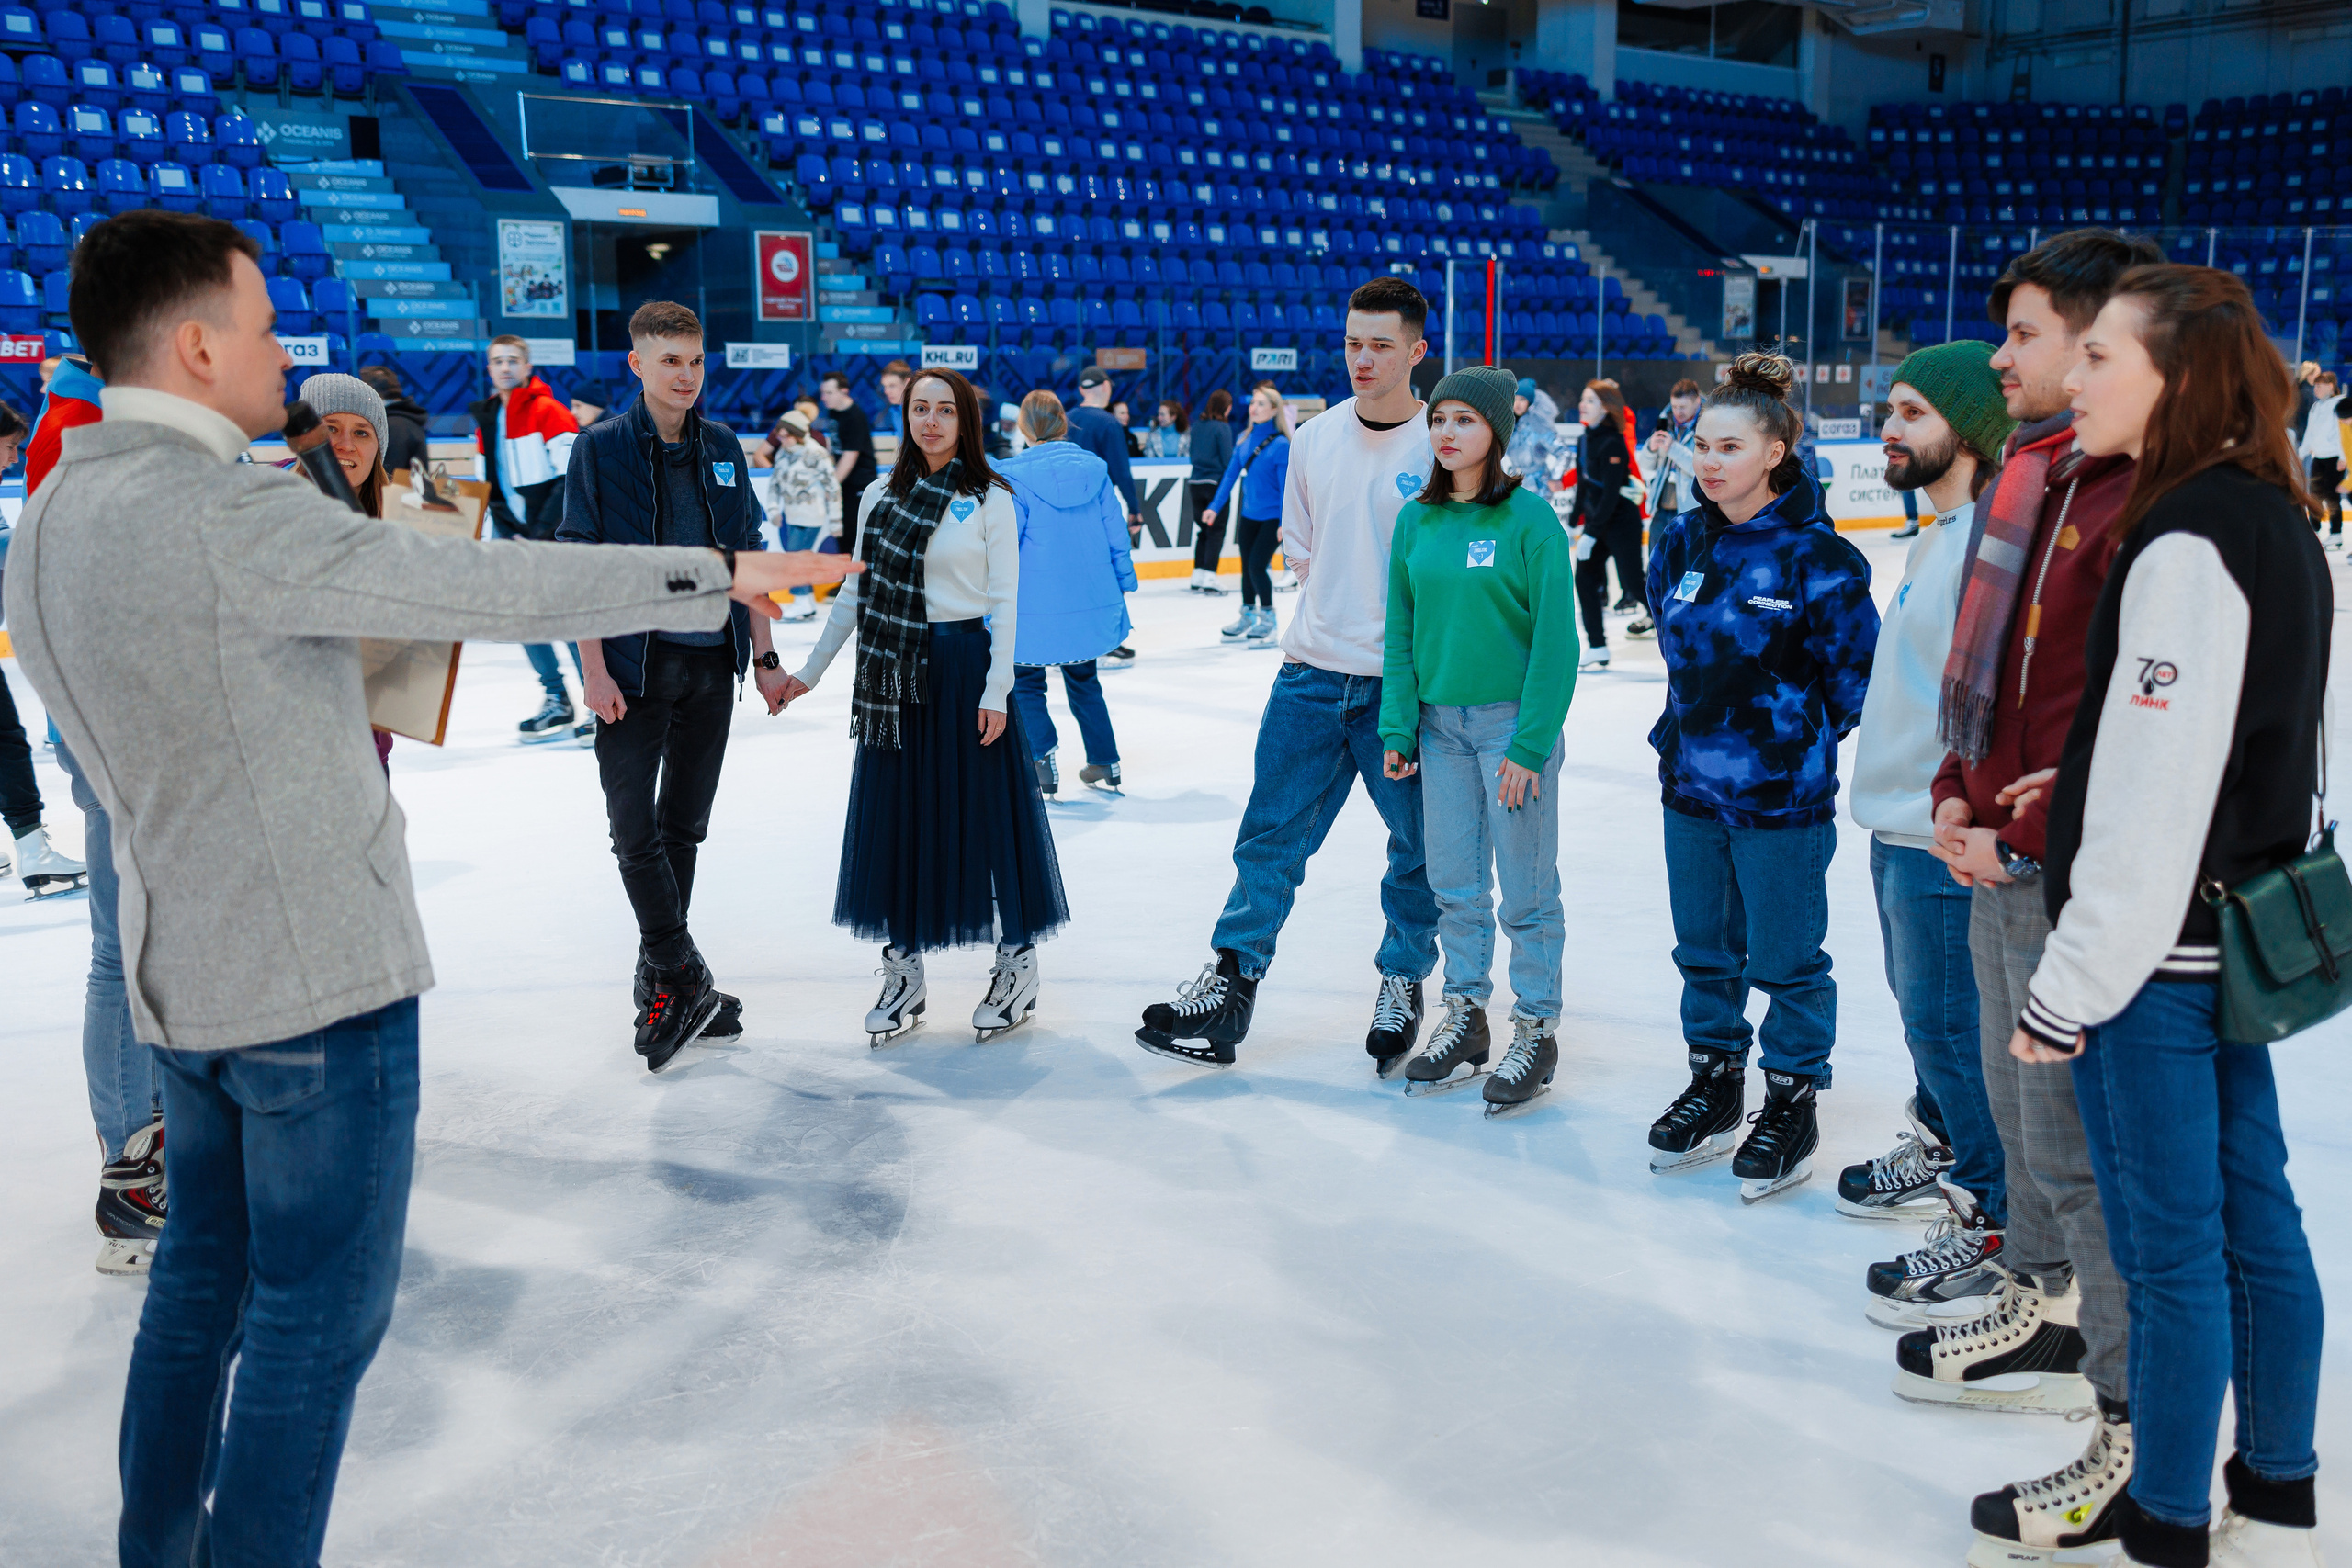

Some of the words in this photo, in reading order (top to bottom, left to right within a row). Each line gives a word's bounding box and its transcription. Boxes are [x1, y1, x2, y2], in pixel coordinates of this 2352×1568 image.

[279, 123, 344, 141] OCEANIS
[0, 340, 44, 357] BET
[284, 344, 319, 357] газ
[925, 351, 974, 364] KHL.RU
[1850, 463, 1885, 479] Плат
[1849, 487, 1903, 502] систем
[1747, 599, 1793, 610] CONNECTION
[1752, 595, 1790, 605] FEARLESS
[2137, 656, 2178, 687] 70
[2129, 694, 2170, 711] ЛИНК
[2007, 1553, 2041, 1562] GRAF
